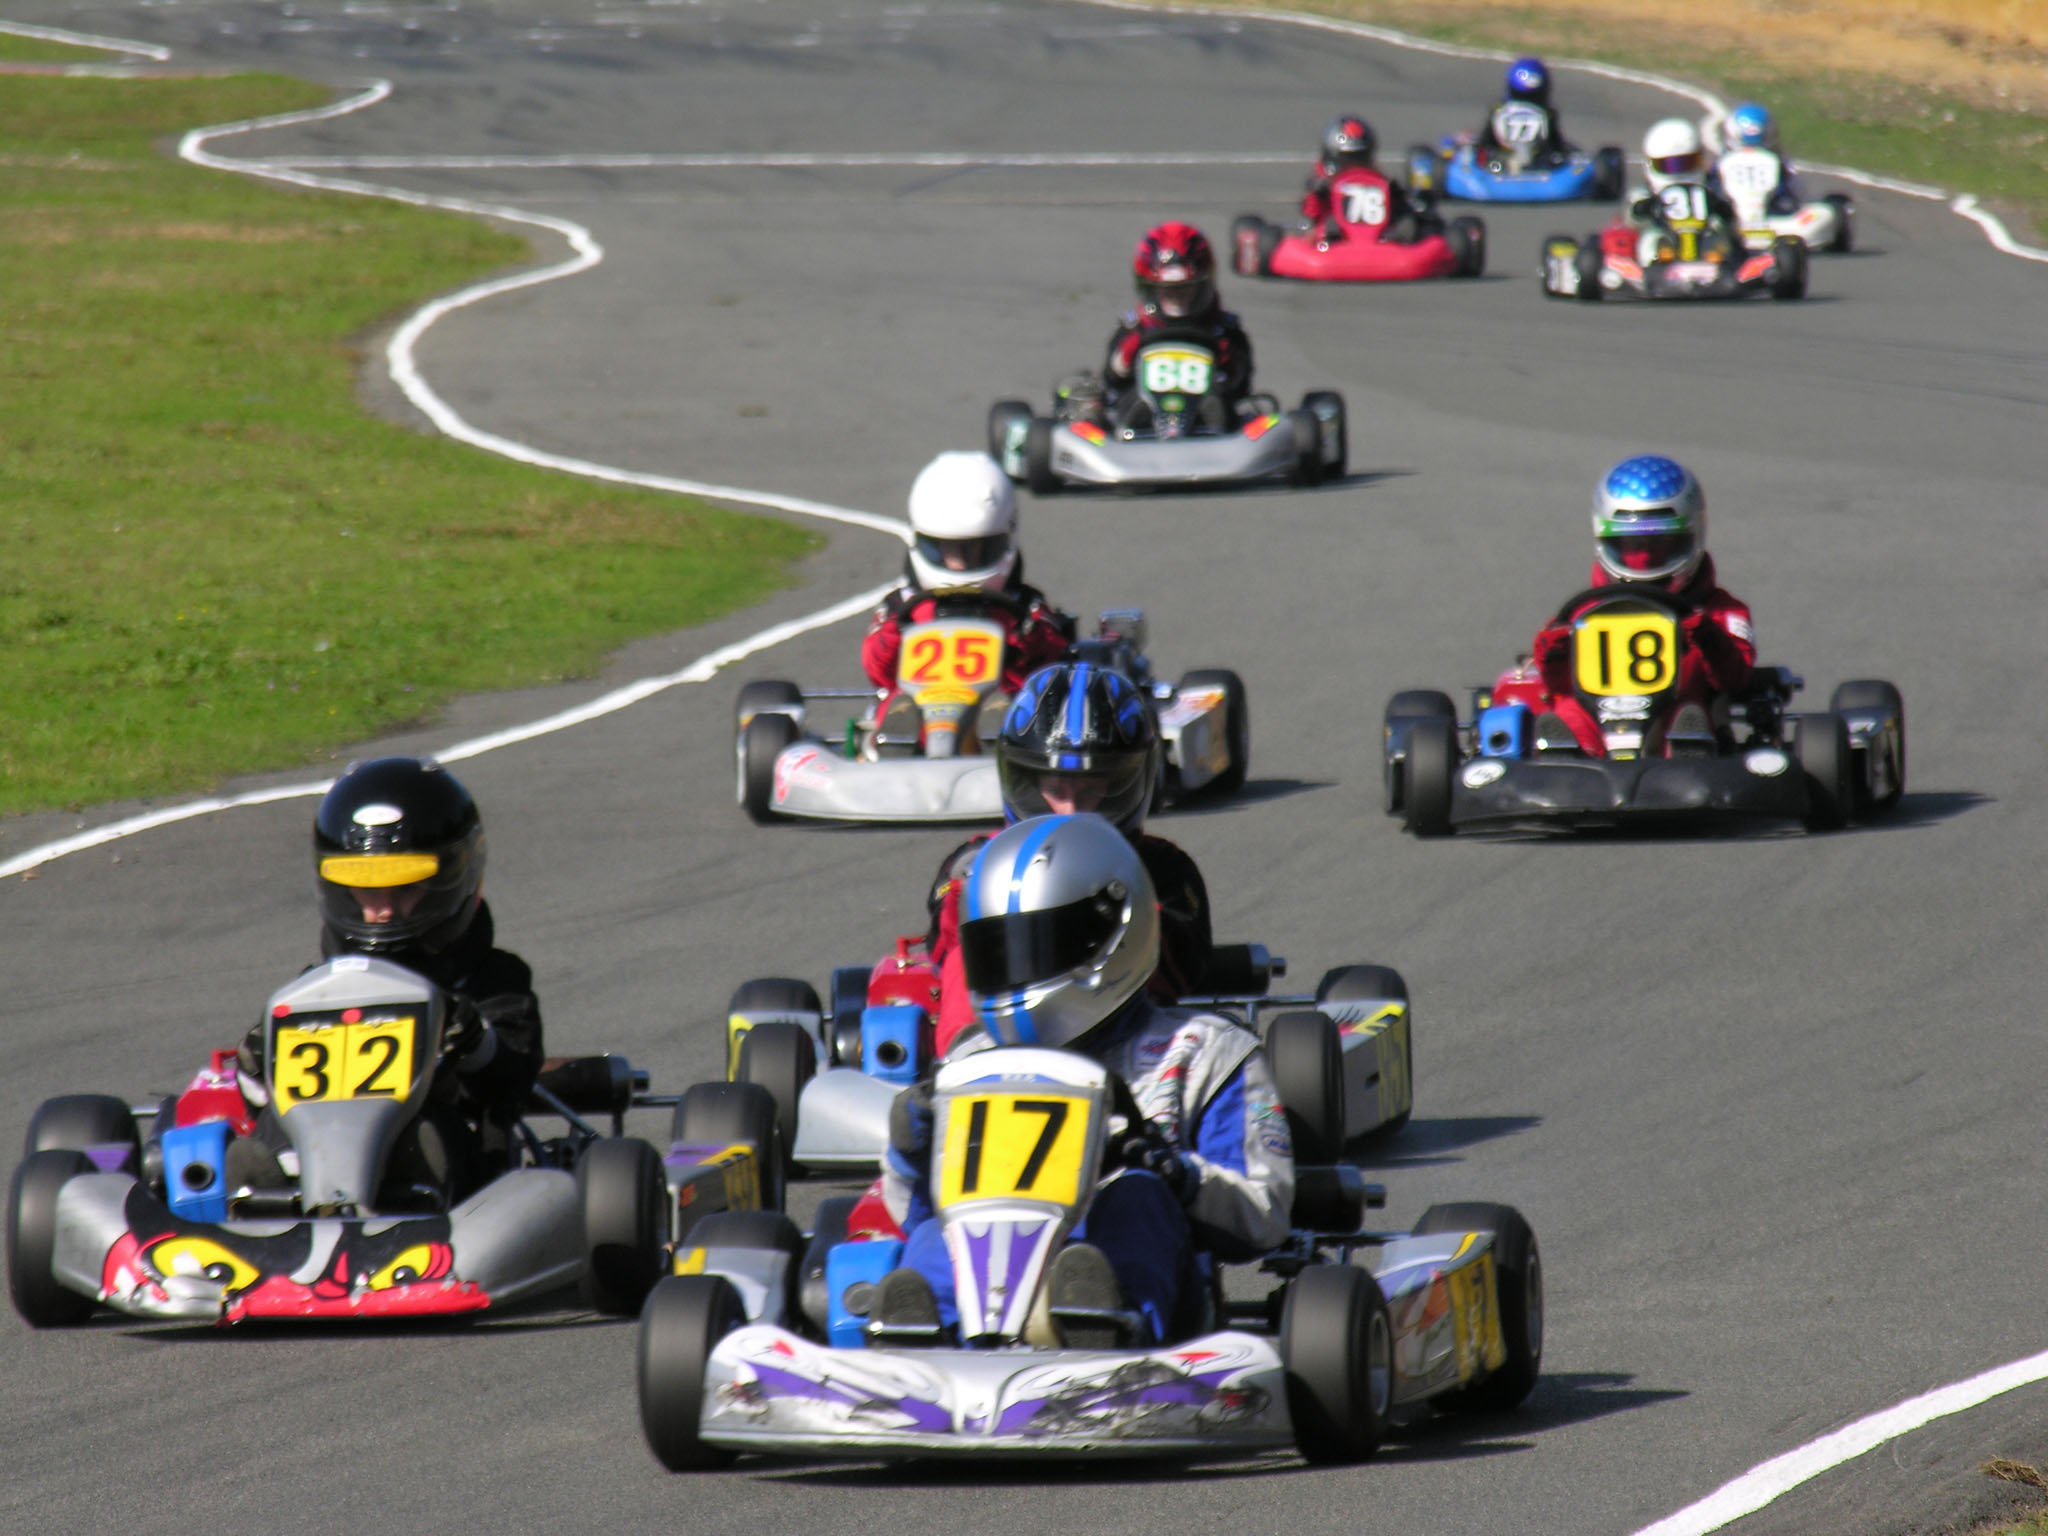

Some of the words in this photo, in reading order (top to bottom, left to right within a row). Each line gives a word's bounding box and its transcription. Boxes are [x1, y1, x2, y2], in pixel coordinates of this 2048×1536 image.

[1660, 186, 1709, 220] 31
[1145, 357, 1210, 395] 68
[911, 637, 990, 683] 25
[1598, 629, 1666, 687] 18
[287, 1035, 400, 1101] 32
[961, 1100, 1070, 1194] 17
